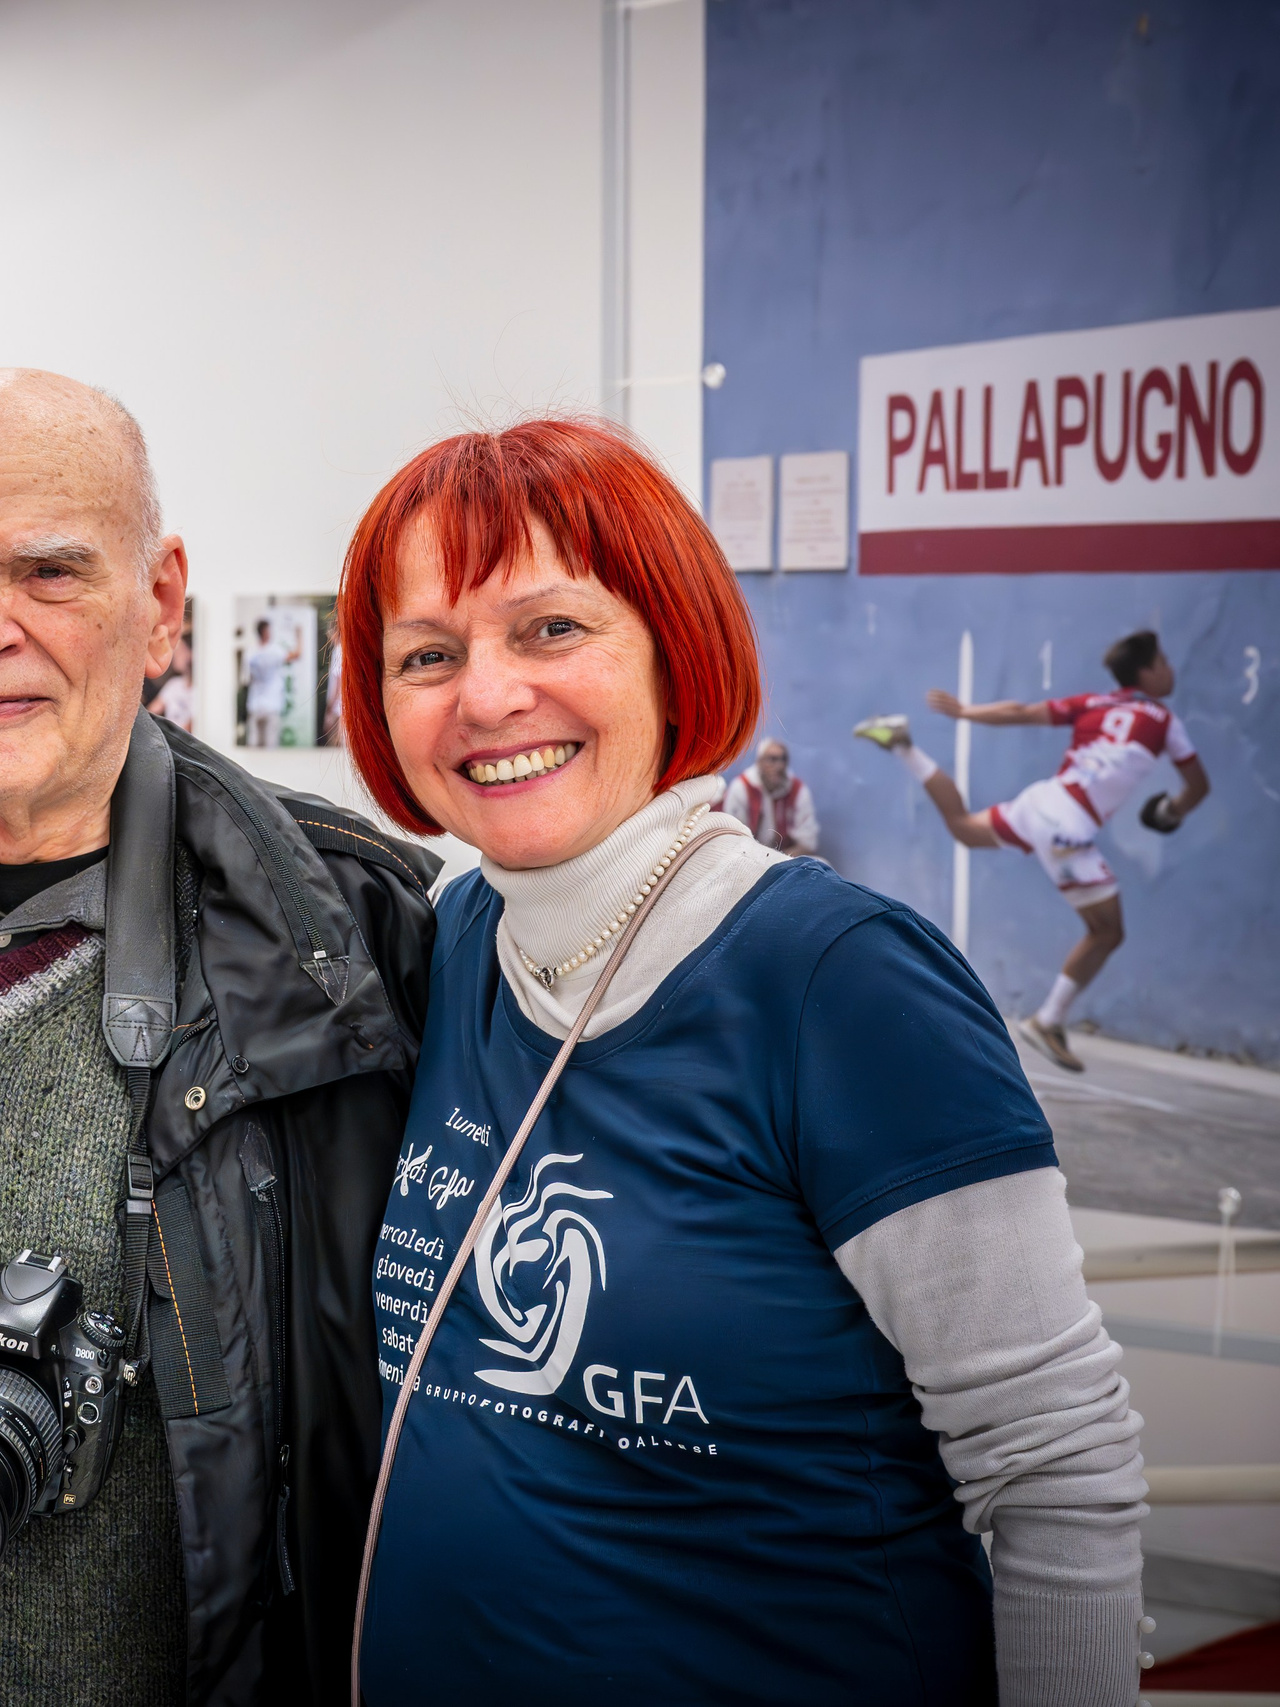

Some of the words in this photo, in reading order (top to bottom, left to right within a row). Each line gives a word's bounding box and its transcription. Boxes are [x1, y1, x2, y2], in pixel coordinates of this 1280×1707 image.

[887, 357, 1265, 495] PALLAPUGNO
[1101, 707, 1135, 743] 9
[428, 1166, 474, 1210] Gfa
[376, 1254, 435, 1292] giovedì
[375, 1291, 428, 1324] venerdì
[75, 1347, 95, 1360] D800
[382, 1326, 421, 1355] sabat
[583, 1364, 709, 1425] GFA
